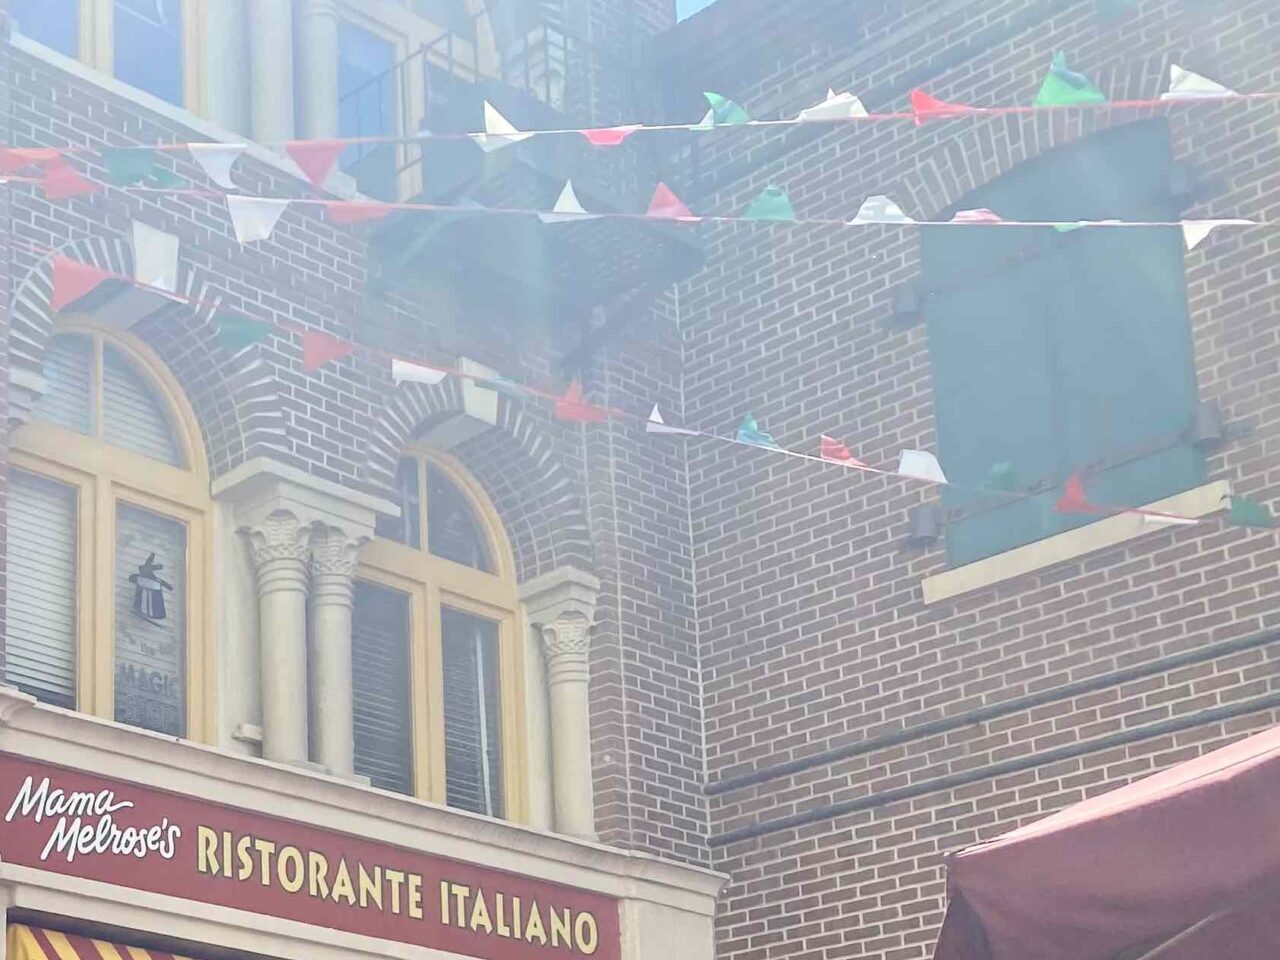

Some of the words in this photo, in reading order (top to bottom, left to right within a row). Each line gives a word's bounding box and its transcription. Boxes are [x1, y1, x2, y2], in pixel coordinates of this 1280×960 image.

[5, 776, 134, 823] Mama
[40, 814, 181, 862] Melrose's
[197, 825, 424, 919] RISTORANTE
[440, 880, 600, 955] ITALIANO
